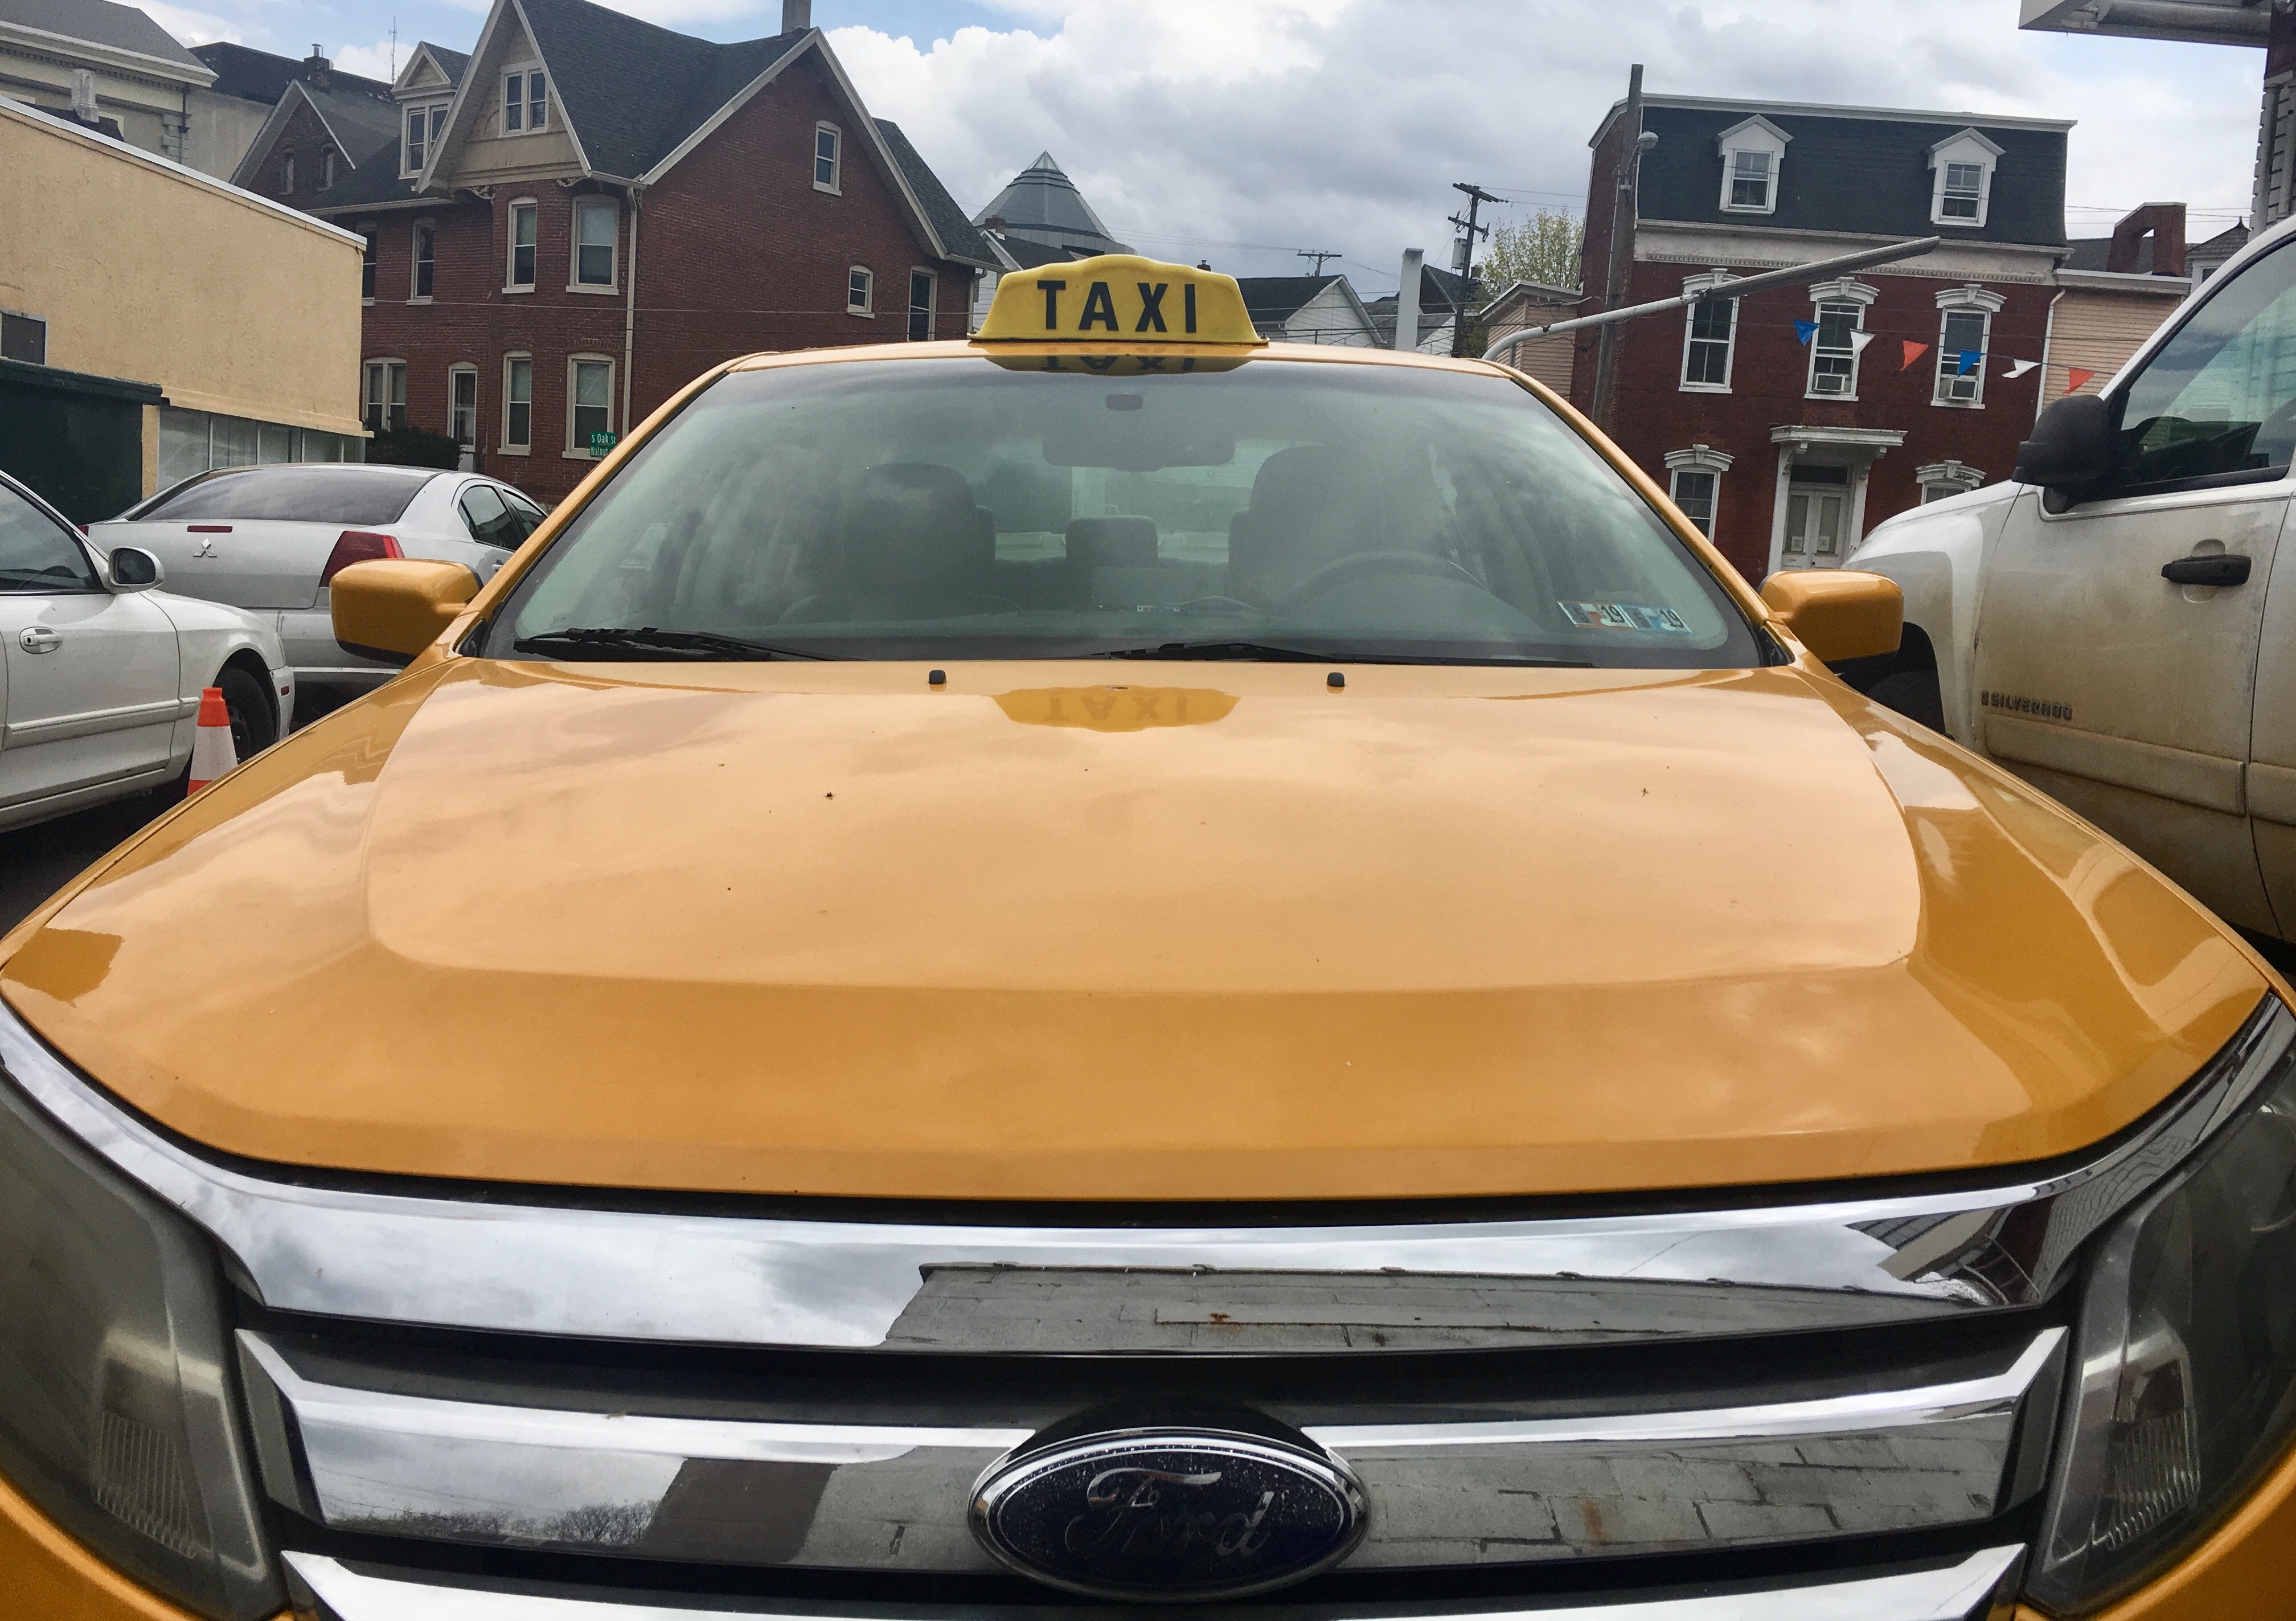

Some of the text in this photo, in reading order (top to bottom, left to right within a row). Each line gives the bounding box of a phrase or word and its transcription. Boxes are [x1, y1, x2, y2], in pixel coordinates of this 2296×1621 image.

[1037, 280, 1196, 333] TAXI
[597, 433, 609, 443] Oak
[591, 447, 608, 456] Walnut
[1573, 605, 1625, 623] 5 19
[1659, 609, 1684, 628] 19
[1990, 691, 2073, 721] SILVERADO
[1064, 1467, 1275, 1558] Ford
